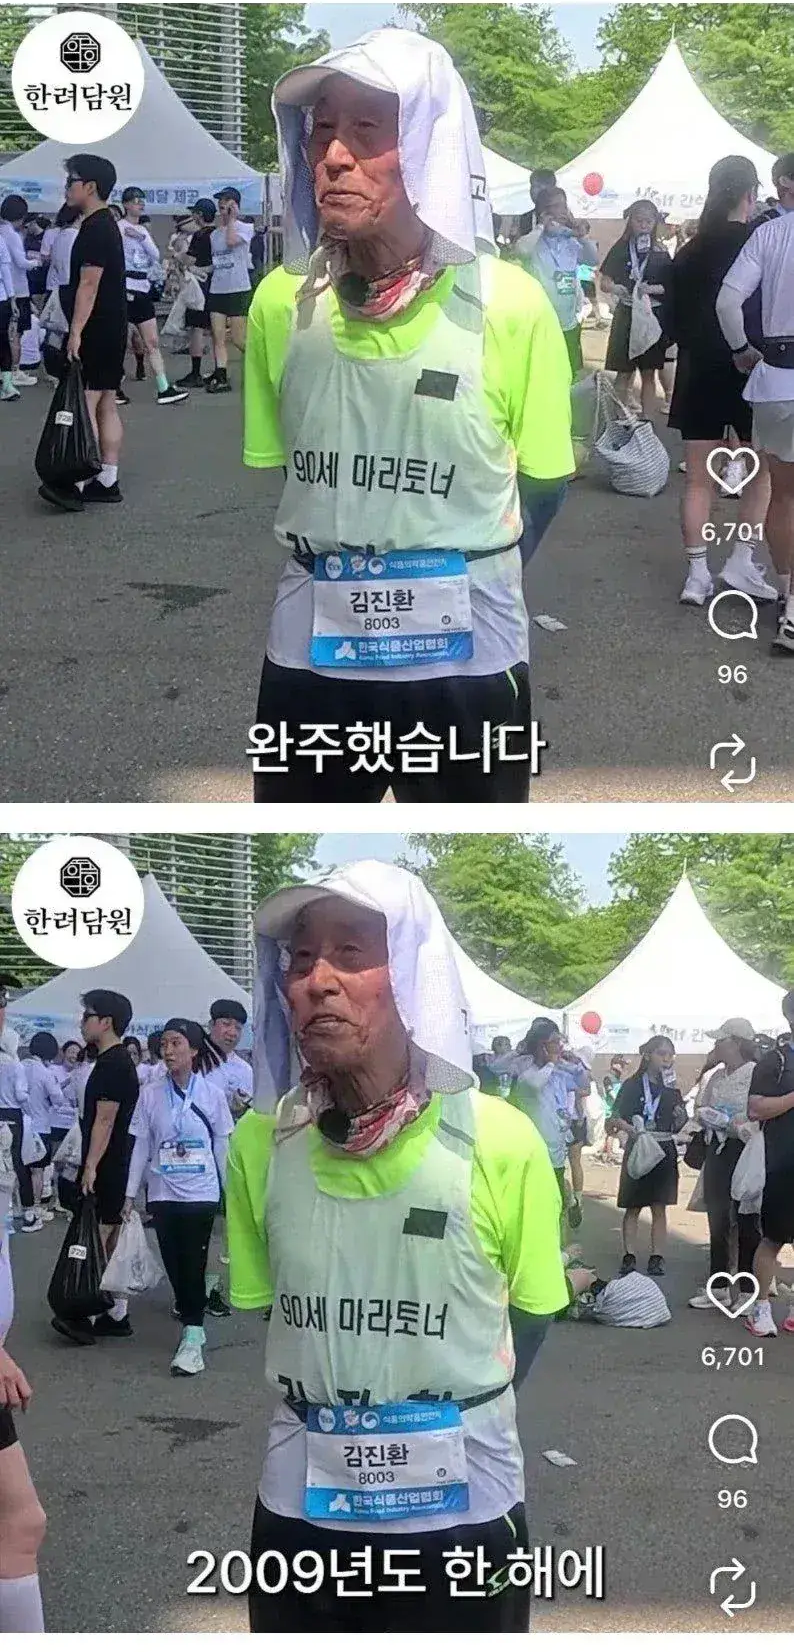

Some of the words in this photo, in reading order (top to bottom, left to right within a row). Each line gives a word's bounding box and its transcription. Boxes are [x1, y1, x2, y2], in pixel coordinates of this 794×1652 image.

[293, 449, 339, 488] 90세
[352, 454, 455, 499] 마라토너
[349, 589, 415, 613] 김진환
[363, 617, 400, 631] 8003
[280, 1293, 329, 1333] 90세
[338, 1298, 449, 1340] 마라토너
[343, 1443, 409, 1467] 김진환
[358, 1471, 395, 1485] 8003
